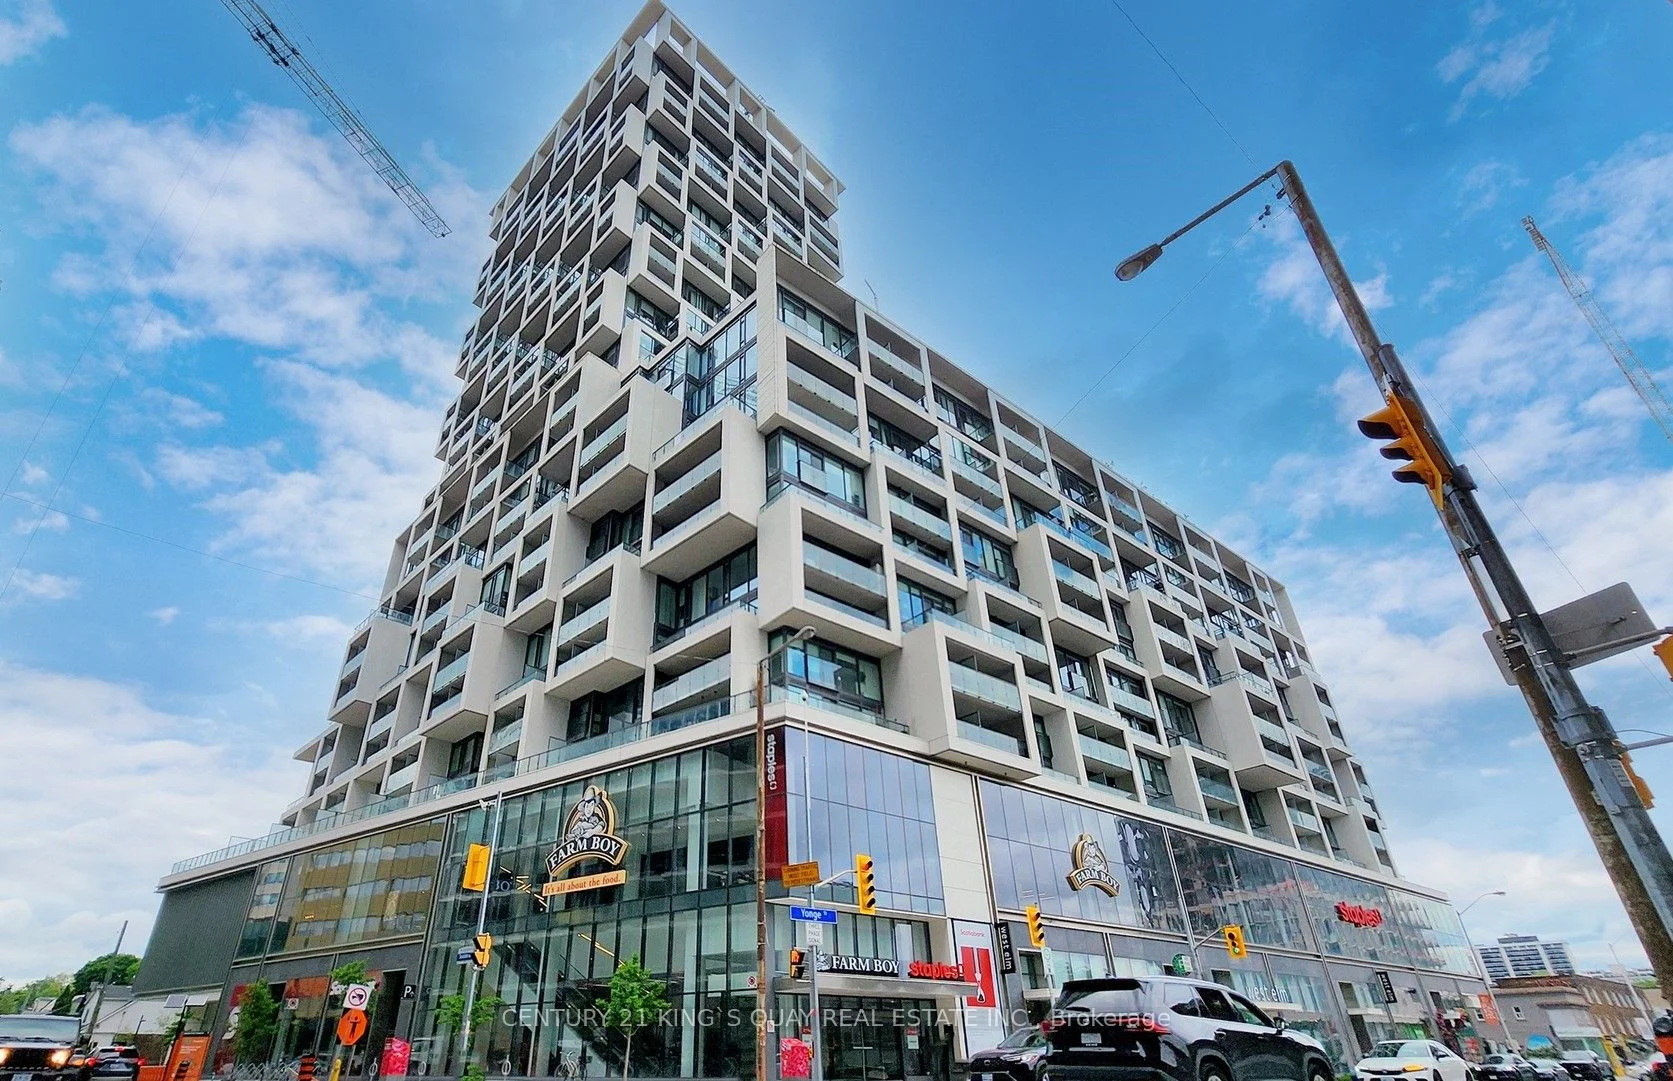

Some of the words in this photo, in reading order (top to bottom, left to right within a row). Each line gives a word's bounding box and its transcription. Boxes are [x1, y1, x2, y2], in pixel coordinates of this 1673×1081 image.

[766, 734, 777, 782] staples
[549, 838, 588, 869] FARM
[591, 836, 621, 857] BOY
[544, 884, 555, 895] It's
[556, 882, 566, 892] all
[567, 880, 587, 891] about
[588, 877, 600, 887] the
[602, 874, 621, 885] food.
[1074, 867, 1099, 885] FARM
[1100, 873, 1119, 890] BOY
[801, 908, 822, 920] Yonge
[1000, 926, 1010, 950] west
[832, 955, 871, 972] FARM
[874, 958, 900, 974] BOY
[1004, 951, 1012, 970] elm
[403, 985, 412, 998] P
[1246, 984, 1270, 1001] west
[1271, 984, 1289, 1002] elm
